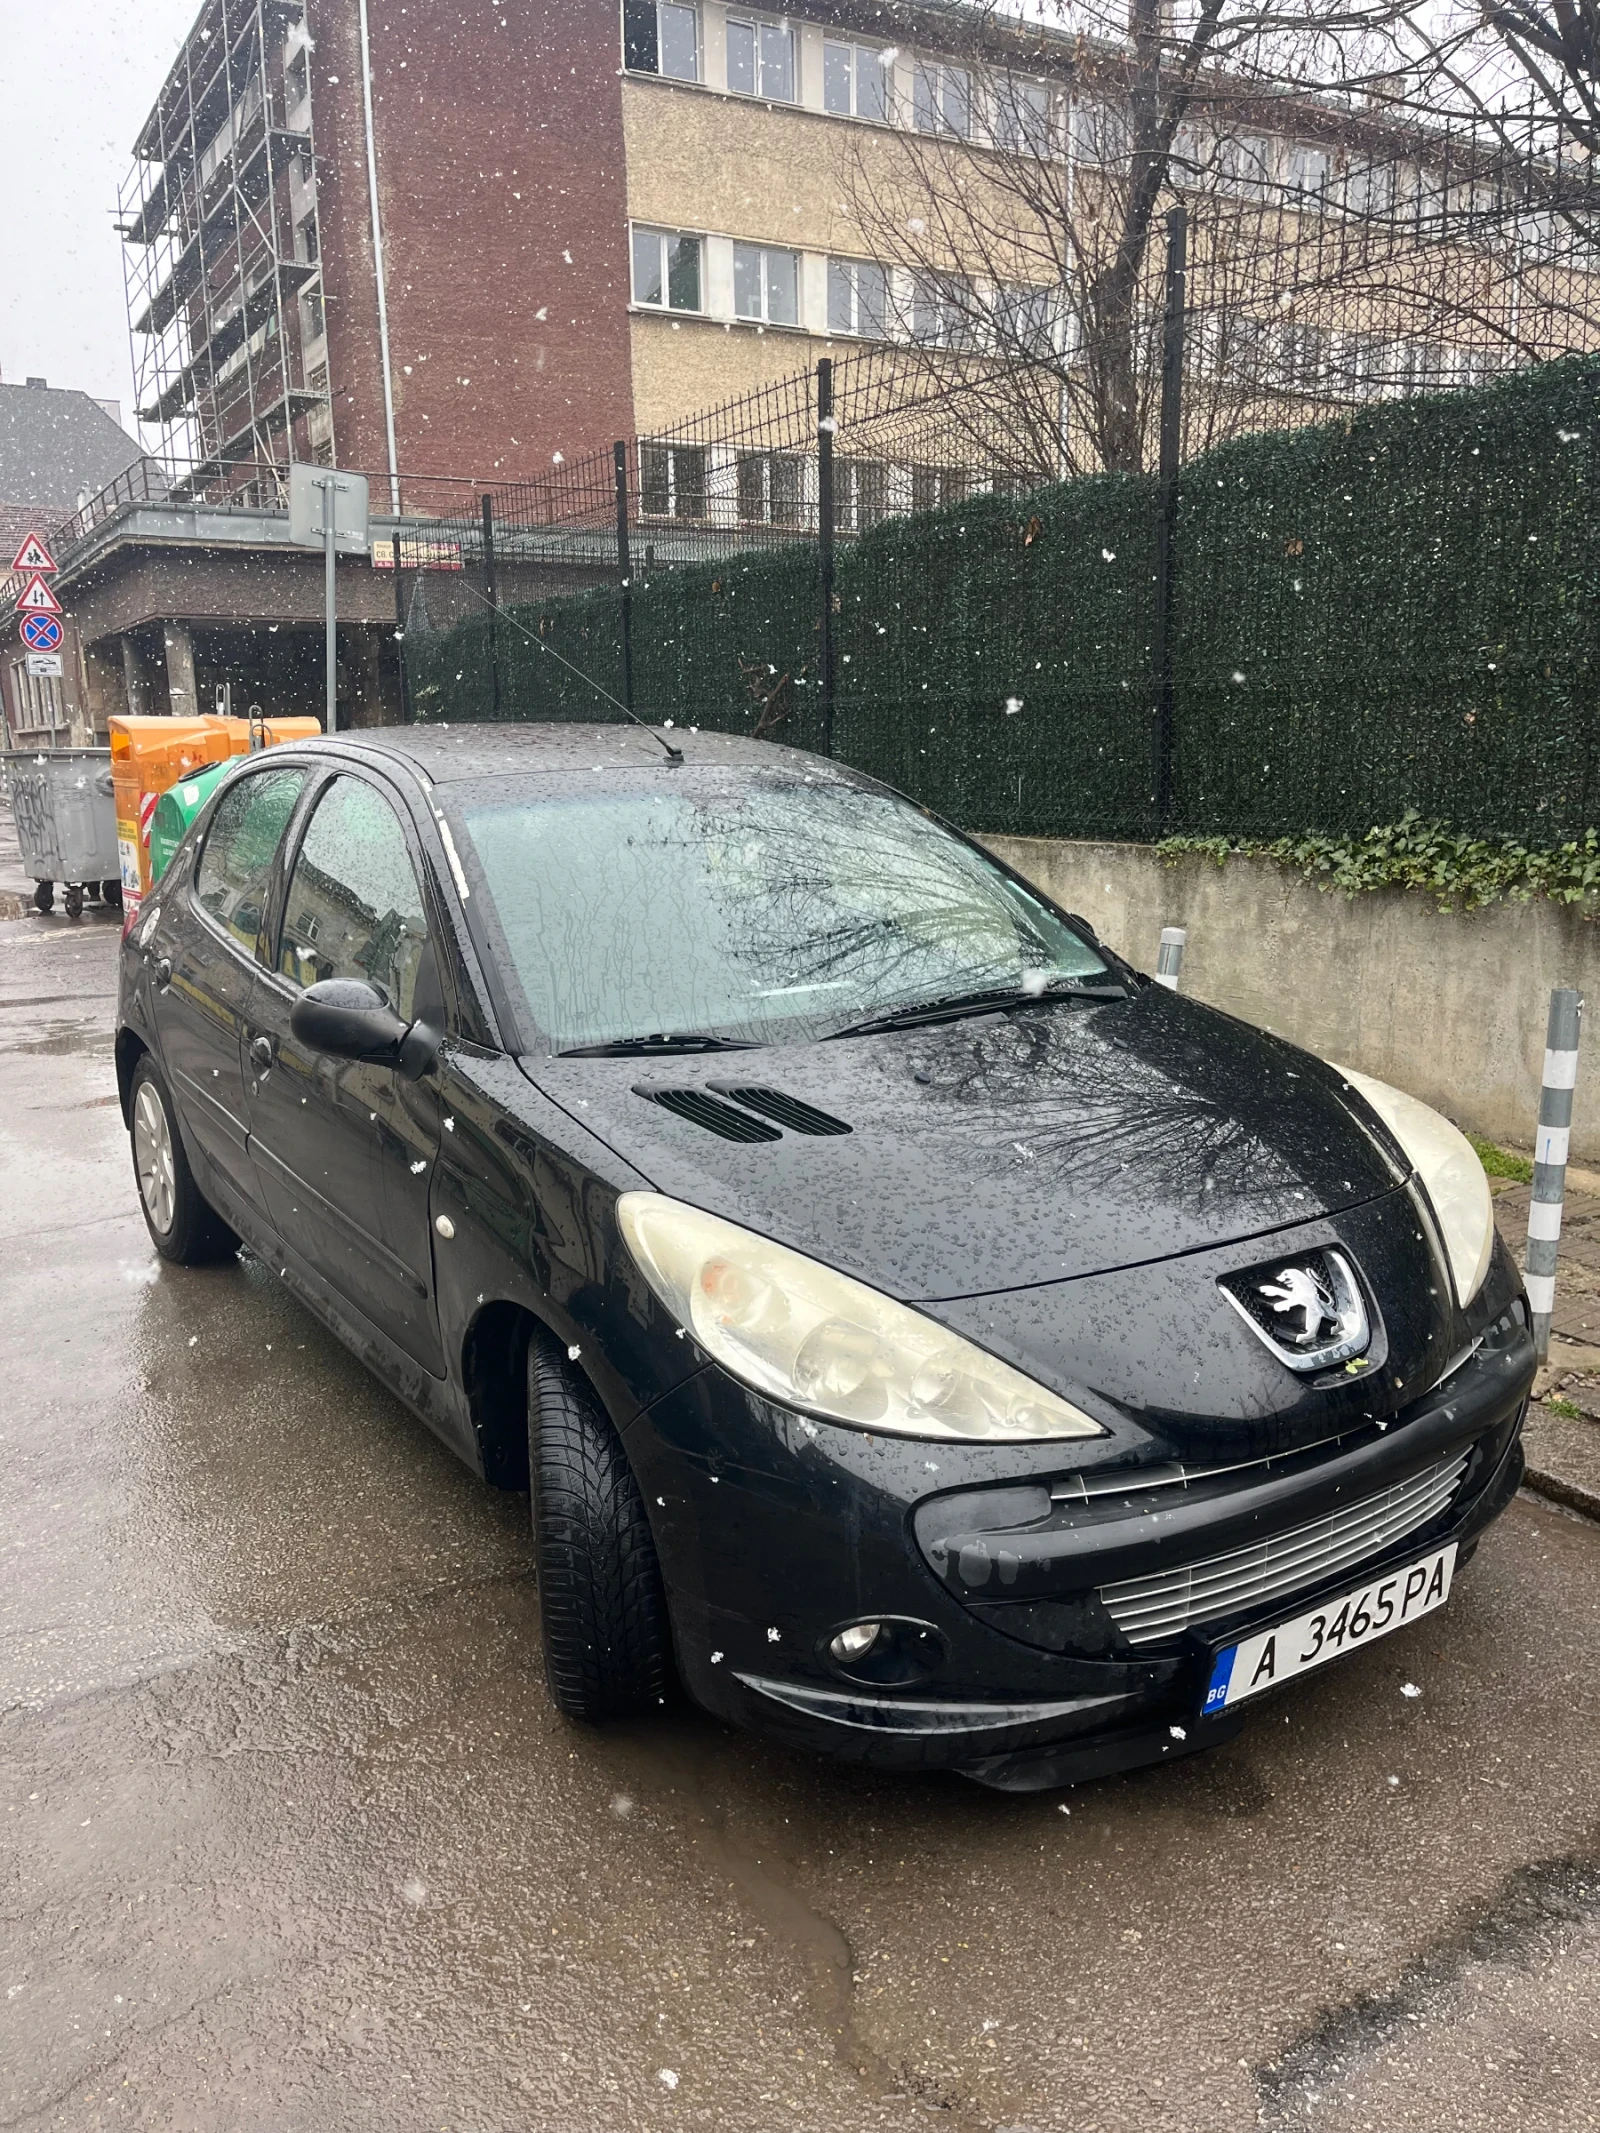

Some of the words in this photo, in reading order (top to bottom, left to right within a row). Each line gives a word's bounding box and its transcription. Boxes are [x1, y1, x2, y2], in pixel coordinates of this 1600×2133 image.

[1250, 1635, 1276, 1687] A
[1300, 1580, 1397, 1663] 3465
[1206, 1684, 1227, 1704] BG
